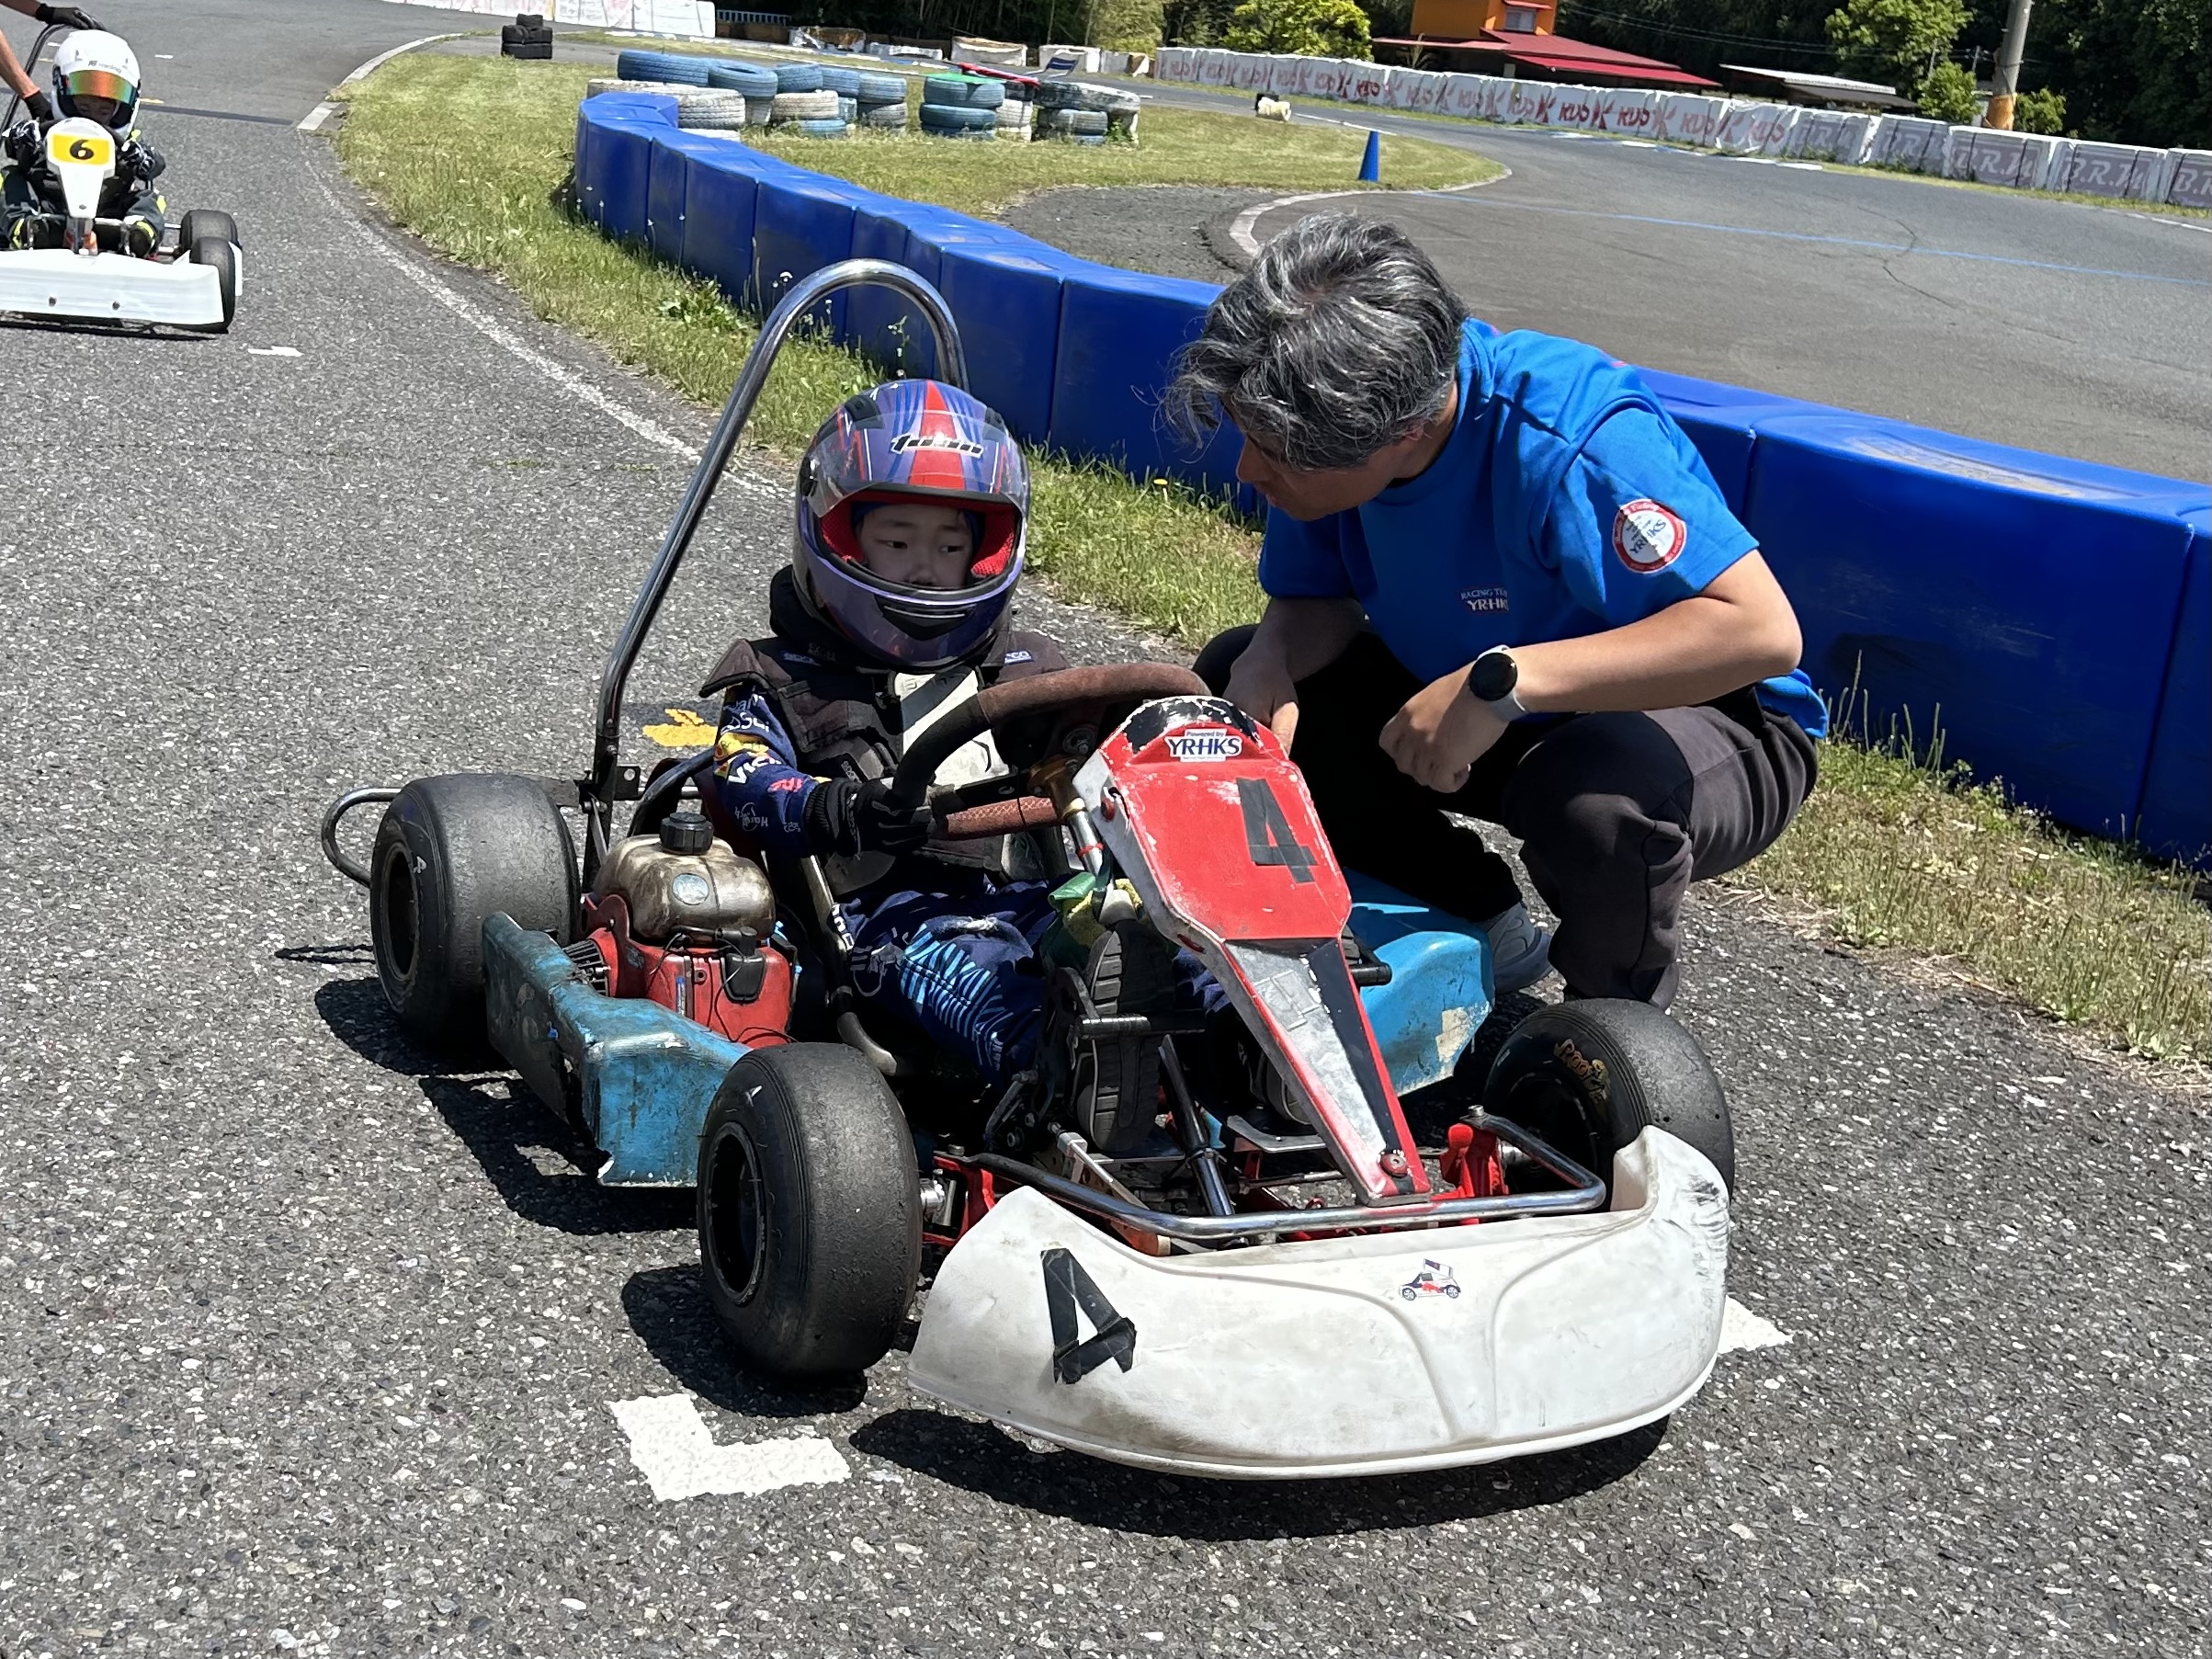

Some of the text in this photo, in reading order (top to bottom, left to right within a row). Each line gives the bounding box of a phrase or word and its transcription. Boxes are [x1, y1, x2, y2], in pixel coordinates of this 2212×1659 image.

[70, 139, 95, 160] 6
[1168, 738, 1241, 756] YRHKS
[1236, 778, 1319, 884] 4
[1039, 1247, 1138, 1385] 4
